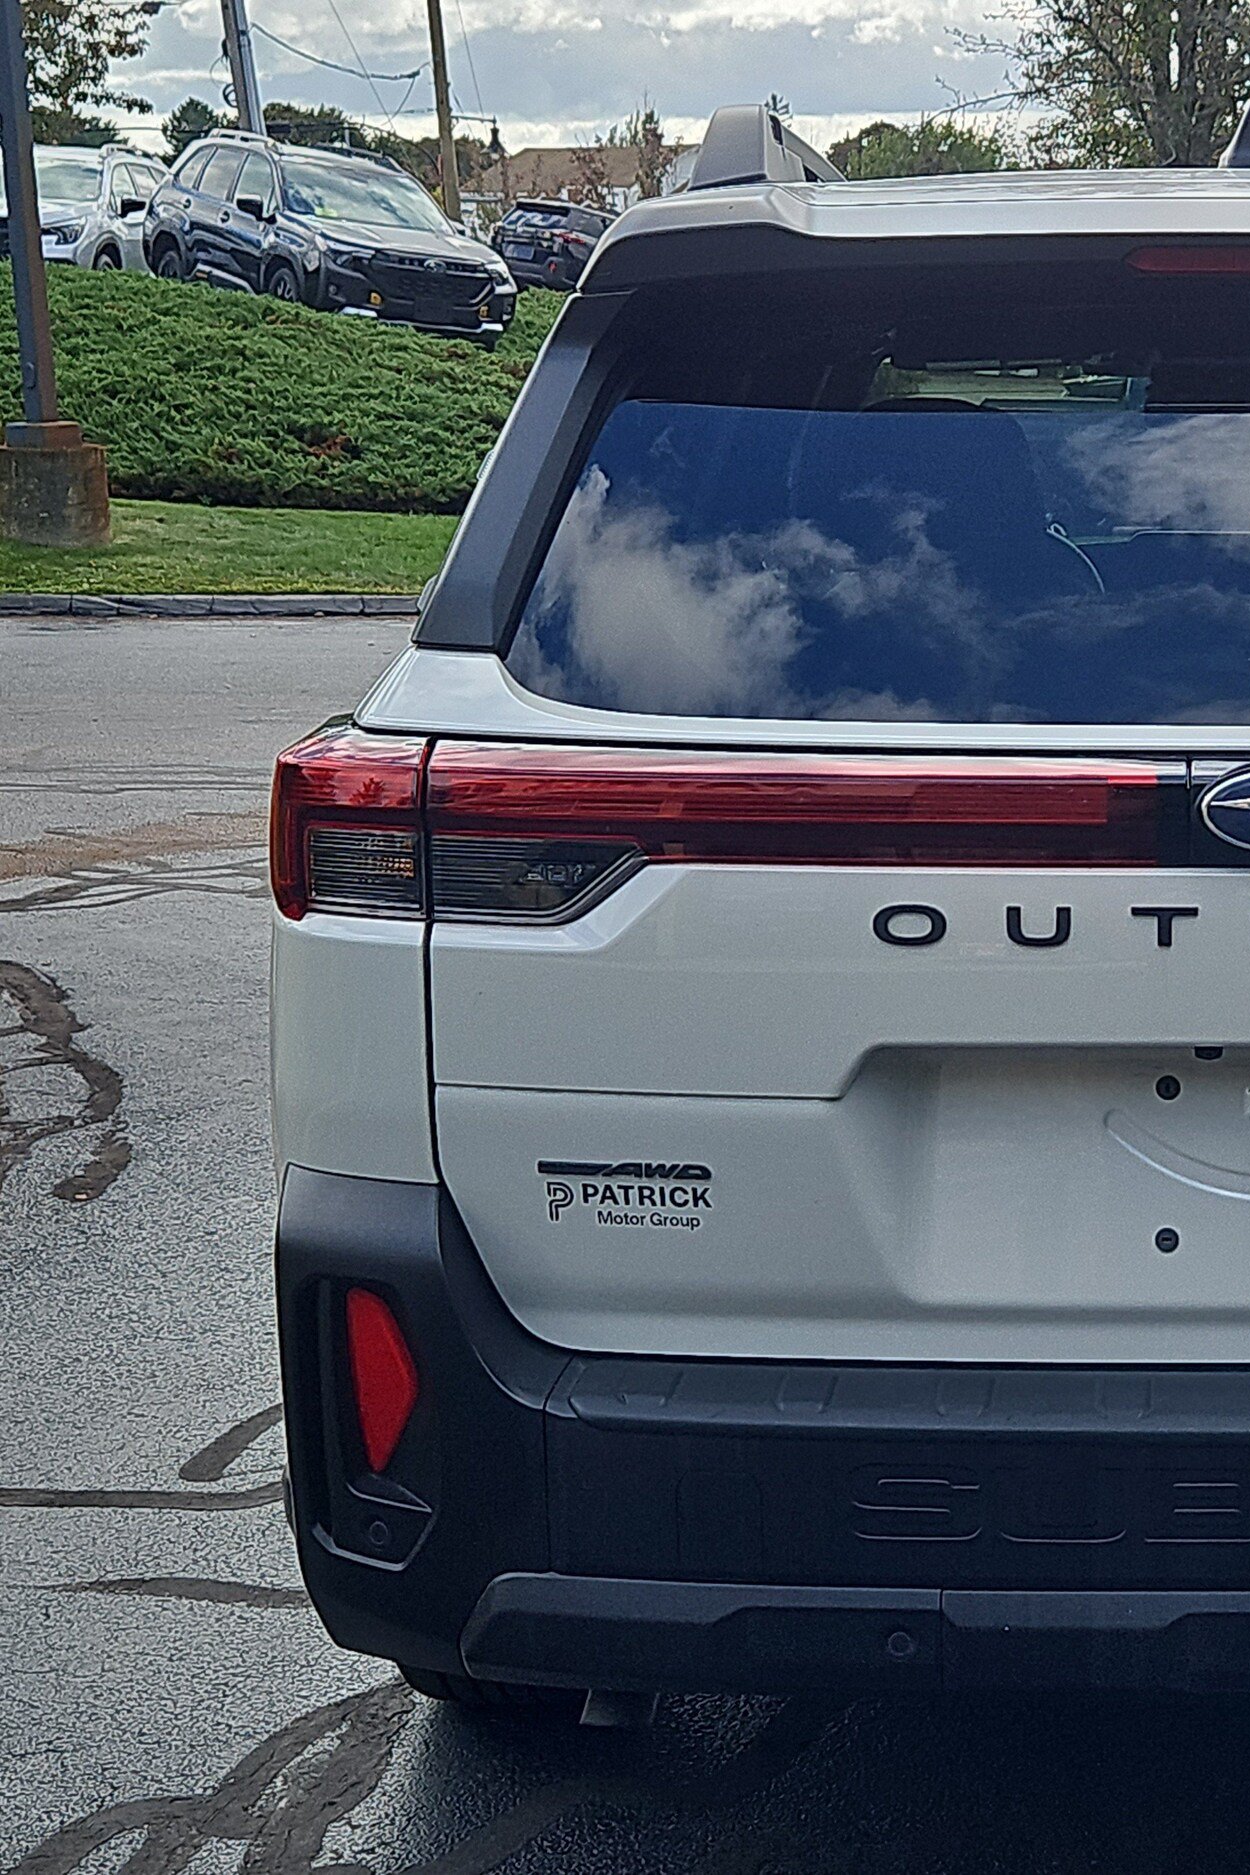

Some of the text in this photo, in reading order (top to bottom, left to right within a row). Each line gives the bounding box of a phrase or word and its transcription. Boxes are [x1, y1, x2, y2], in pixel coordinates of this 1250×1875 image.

[601, 1161, 713, 1180] AWD
[581, 1182, 713, 1209] PATRICK
[597, 1210, 701, 1231] Motor Group
